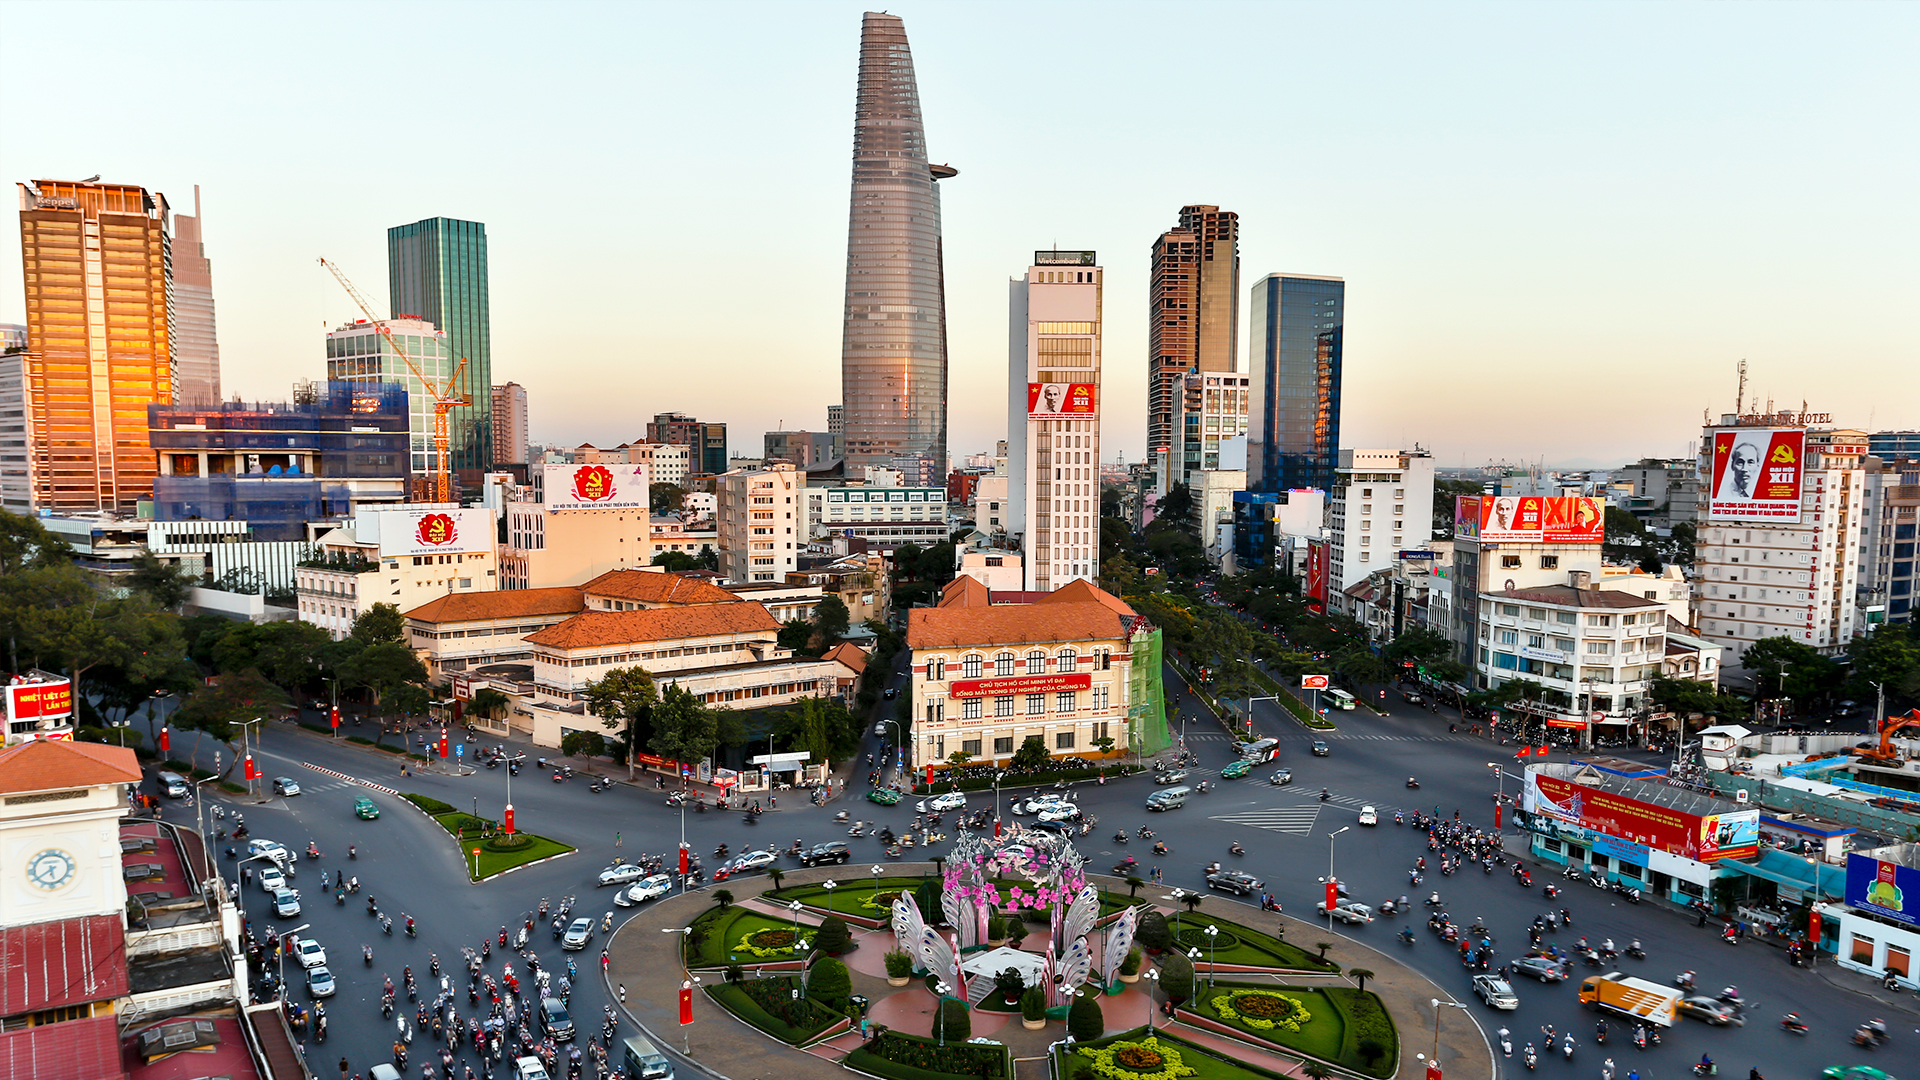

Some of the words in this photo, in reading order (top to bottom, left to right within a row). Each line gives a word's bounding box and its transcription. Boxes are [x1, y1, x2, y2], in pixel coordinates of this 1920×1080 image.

[37, 197, 74, 206] Keppel
[1798, 413, 1832, 424] HOTEL
[1769, 473, 1794, 483] XII
[20, 693, 41, 702] NHIỆT
[43, 692, 58, 700] LIỆT
[46, 701, 60, 710] LẦN
